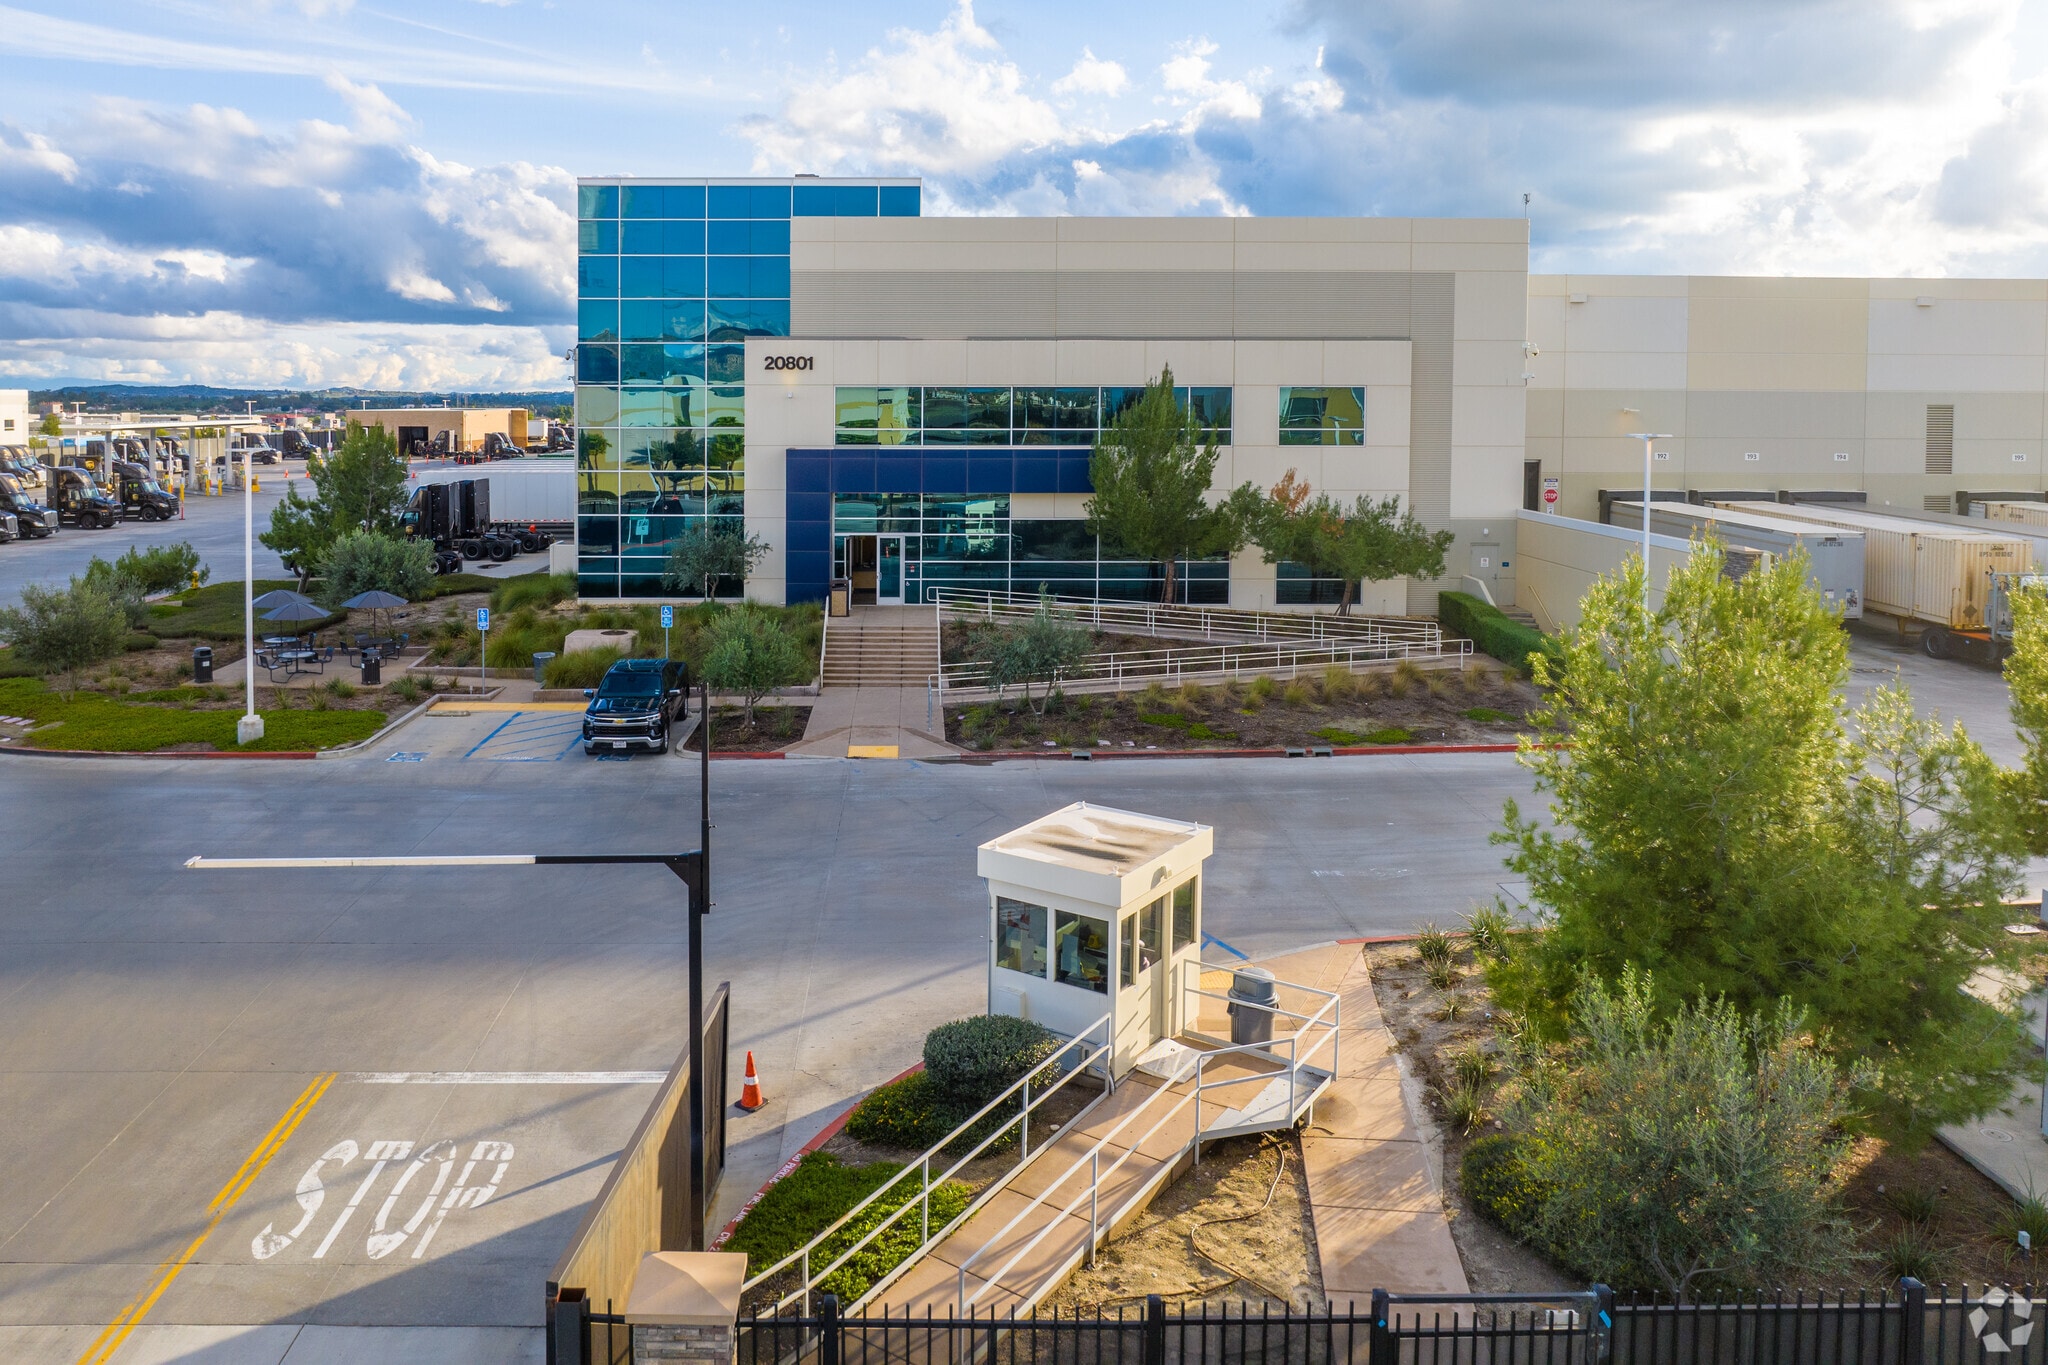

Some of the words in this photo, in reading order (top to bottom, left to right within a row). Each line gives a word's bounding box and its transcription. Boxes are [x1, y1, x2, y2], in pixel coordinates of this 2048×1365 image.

[764, 356, 813, 370] 20801
[251, 1139, 514, 1260] STOP
[747, 1192, 765, 1205] FIRE
[731, 1207, 751, 1223] LANE
